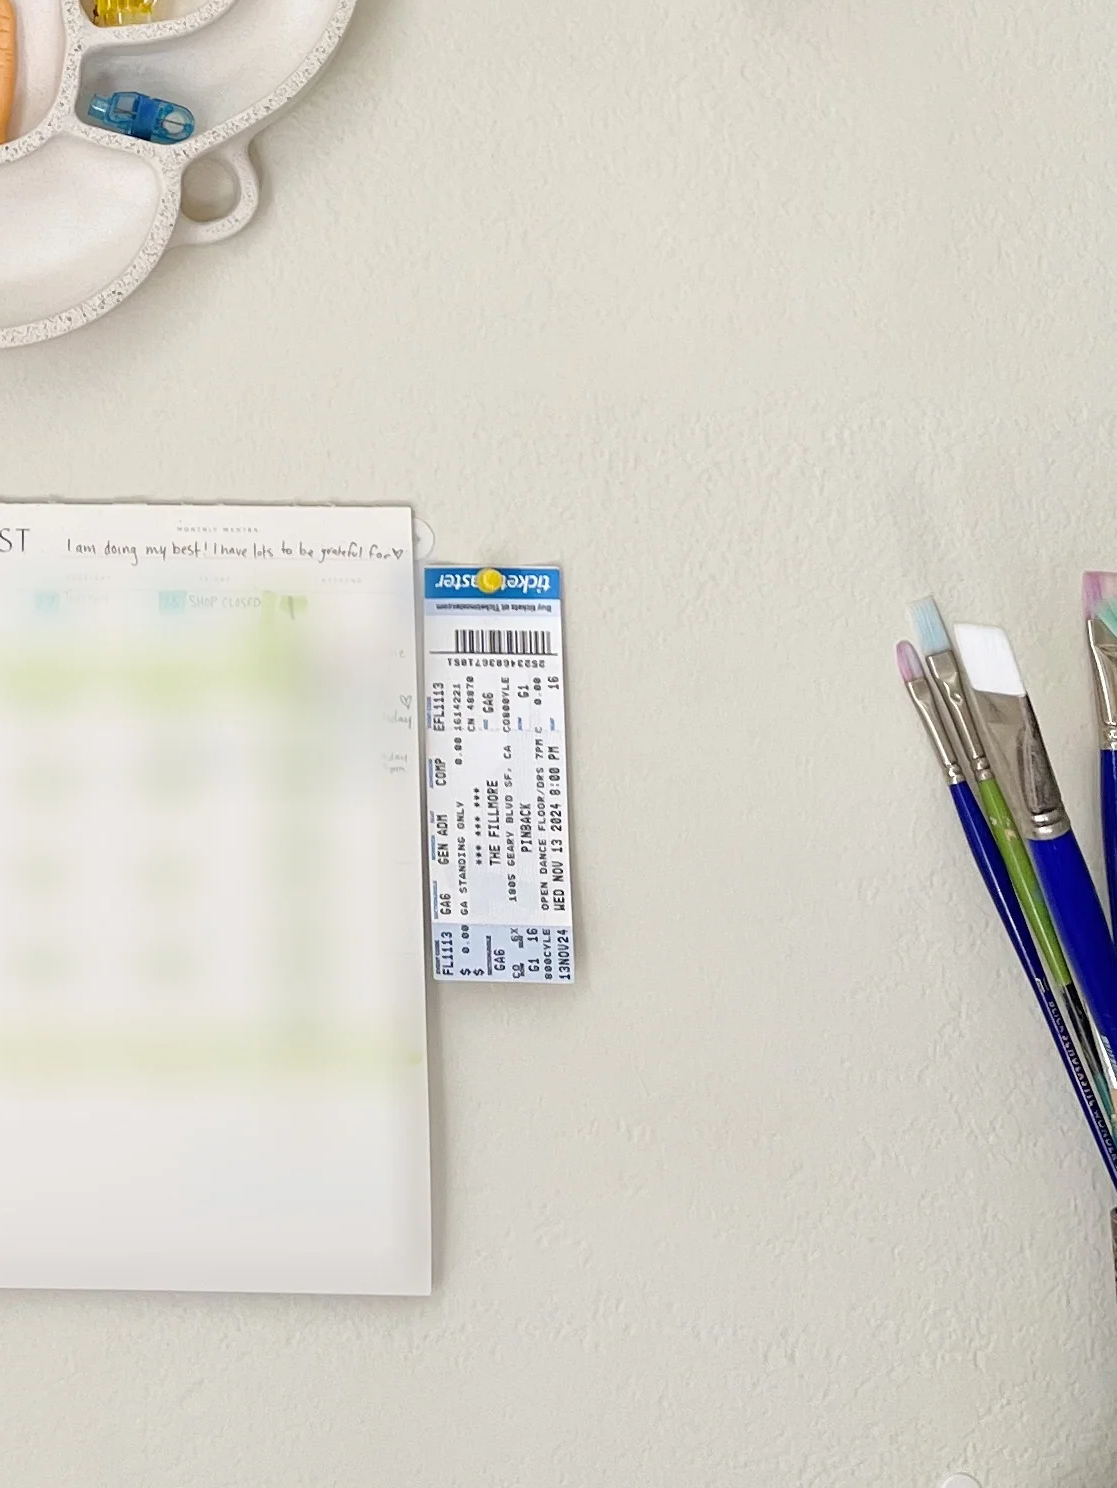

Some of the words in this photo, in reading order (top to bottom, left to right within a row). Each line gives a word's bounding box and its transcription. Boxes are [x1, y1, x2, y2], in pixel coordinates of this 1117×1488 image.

[67, 538, 71, 553] I
[75, 543, 96, 555] am
[104, 540, 139, 567] doing
[145, 544, 167, 562] my
[172, 541, 208, 559] best!
[213, 542, 217, 556] I
[220, 543, 248, 559] have
[253, 542, 274, 560] lots
[281, 540, 293, 556] to
[299, 541, 314, 558] be
[317, 541, 363, 564] grateful
[368, 543, 391, 560] for
[435, 574, 550, 593] ticketaster
[436, 603, 499, 612] Ticketmaster.com
[511, 604, 536, 612] tickets
[518, 685, 529, 698] G1
[534, 677, 542, 705] 0.00
[548, 676, 559, 690] 16
[433, 682, 445, 731] EFL1113
[453, 683, 462, 731] 1614221
[482, 692, 494, 713] GA6
[467, 718, 475, 732] CN
[454, 737, 462, 765] 0.00
[503, 745, 511, 759] CA
[535, 739, 543, 759] 7PM
[548, 746, 560, 760] PM
[435, 758, 447, 786] COMP
[549, 767, 560, 795] 8:00
[486, 780, 500, 838] FILLMORE
[504, 795, 514, 823] BLVD
[535, 767, 546, 831] FLOOR/DRS
[436, 814, 448, 836] ADM
[456, 801, 464, 829] ONLY
[549, 803, 562, 832] 2024
[520, 803, 532, 852] PINBACK
[438, 844, 449, 865] GEN
[489, 844, 500, 866] THE
[506, 831, 515, 867] GEARY
[538, 839, 547, 874] DANCE
[551, 839, 563, 853] 13
[458, 837, 467, 893] STANDING
[552, 861, 564, 882] NOV
[440, 893, 451, 915] GA6
[540, 882, 549, 911] OPEN
[553, 889, 566, 911] WED
[461, 901, 468, 915] GA
[461, 925, 470, 954] 0.00
[527, 928, 538, 942] 16
[441, 931, 454, 976] FL1113
[493, 948, 506, 971] GA6
[558, 929, 571, 980] 13NOV24
[460, 968, 471, 976] $
[473, 968, 484, 976] $
[528, 959, 540, 972] G1
